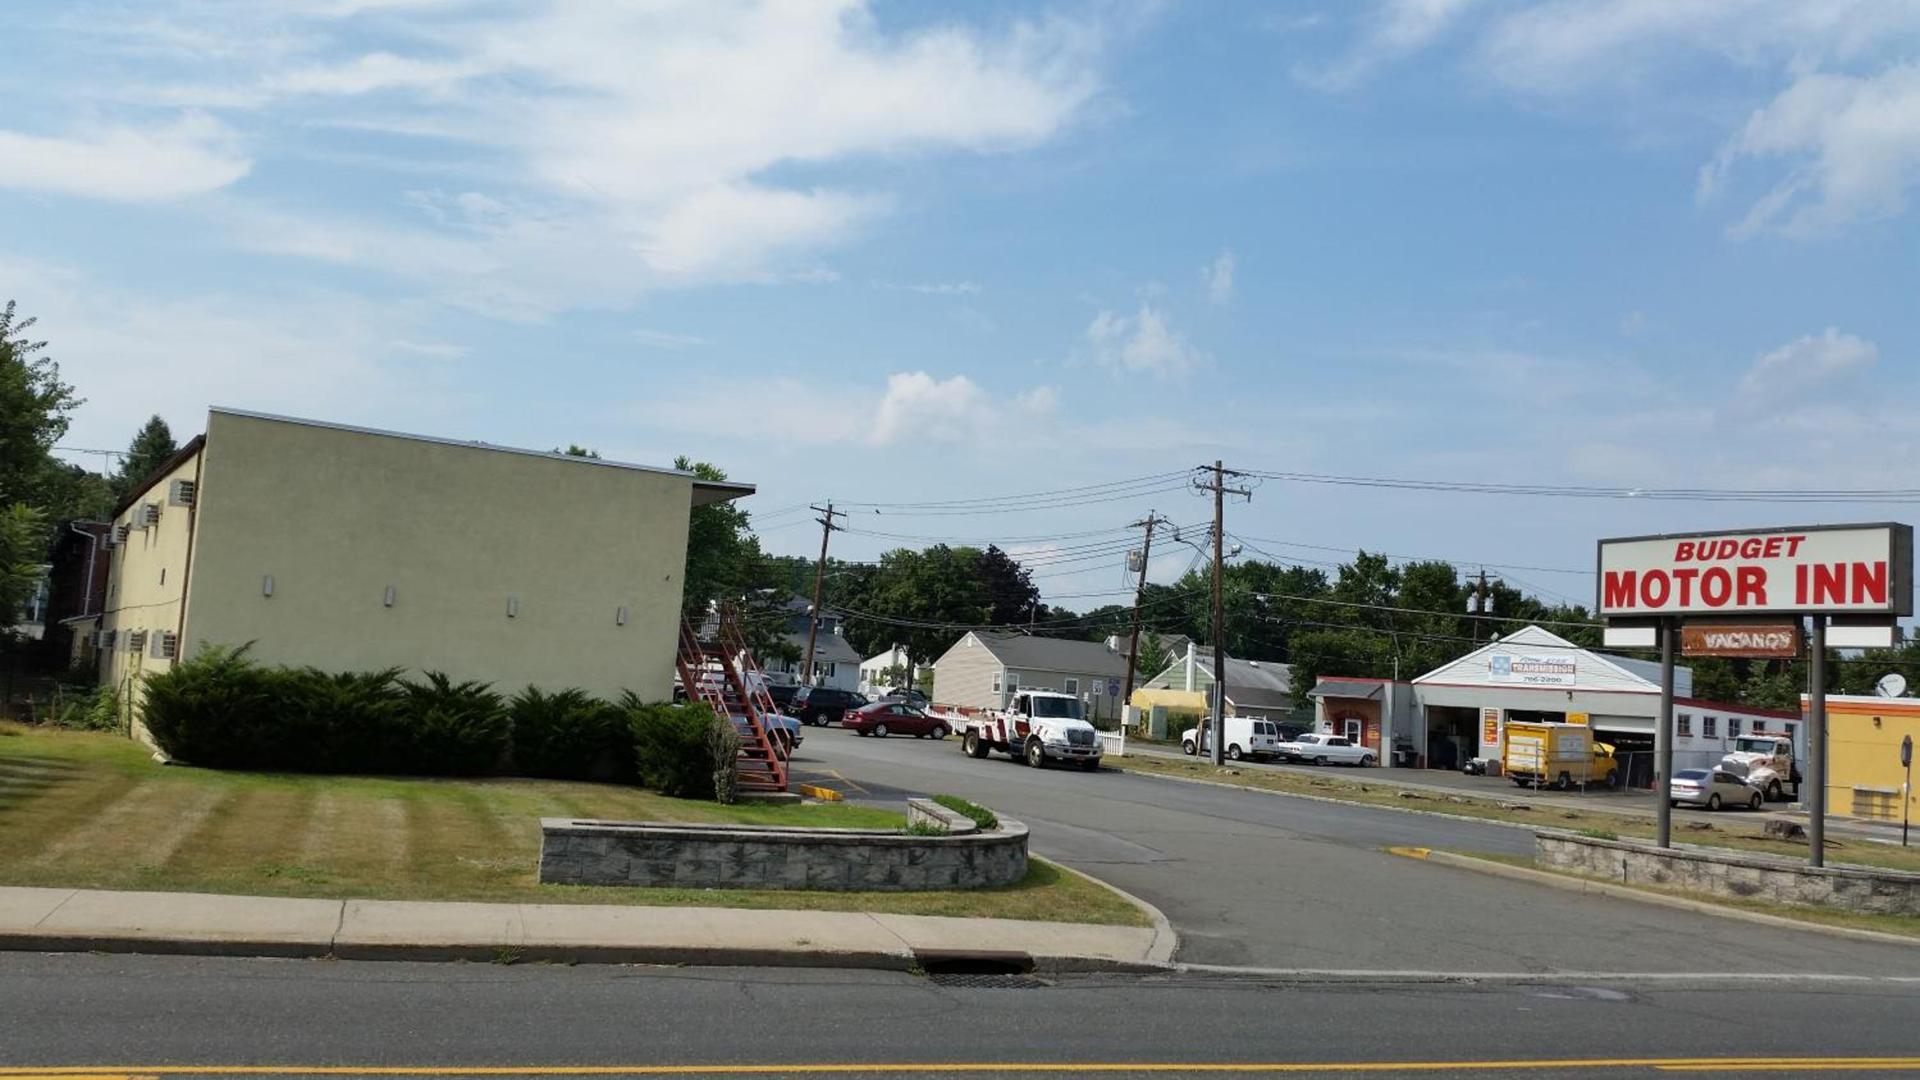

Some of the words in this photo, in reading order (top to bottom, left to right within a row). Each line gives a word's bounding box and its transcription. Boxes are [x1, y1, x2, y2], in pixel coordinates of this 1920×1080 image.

[1675, 536, 1805, 562] BUDGET
[1604, 566, 1767, 608] MOTOR
[1795, 562, 1886, 605] INN
